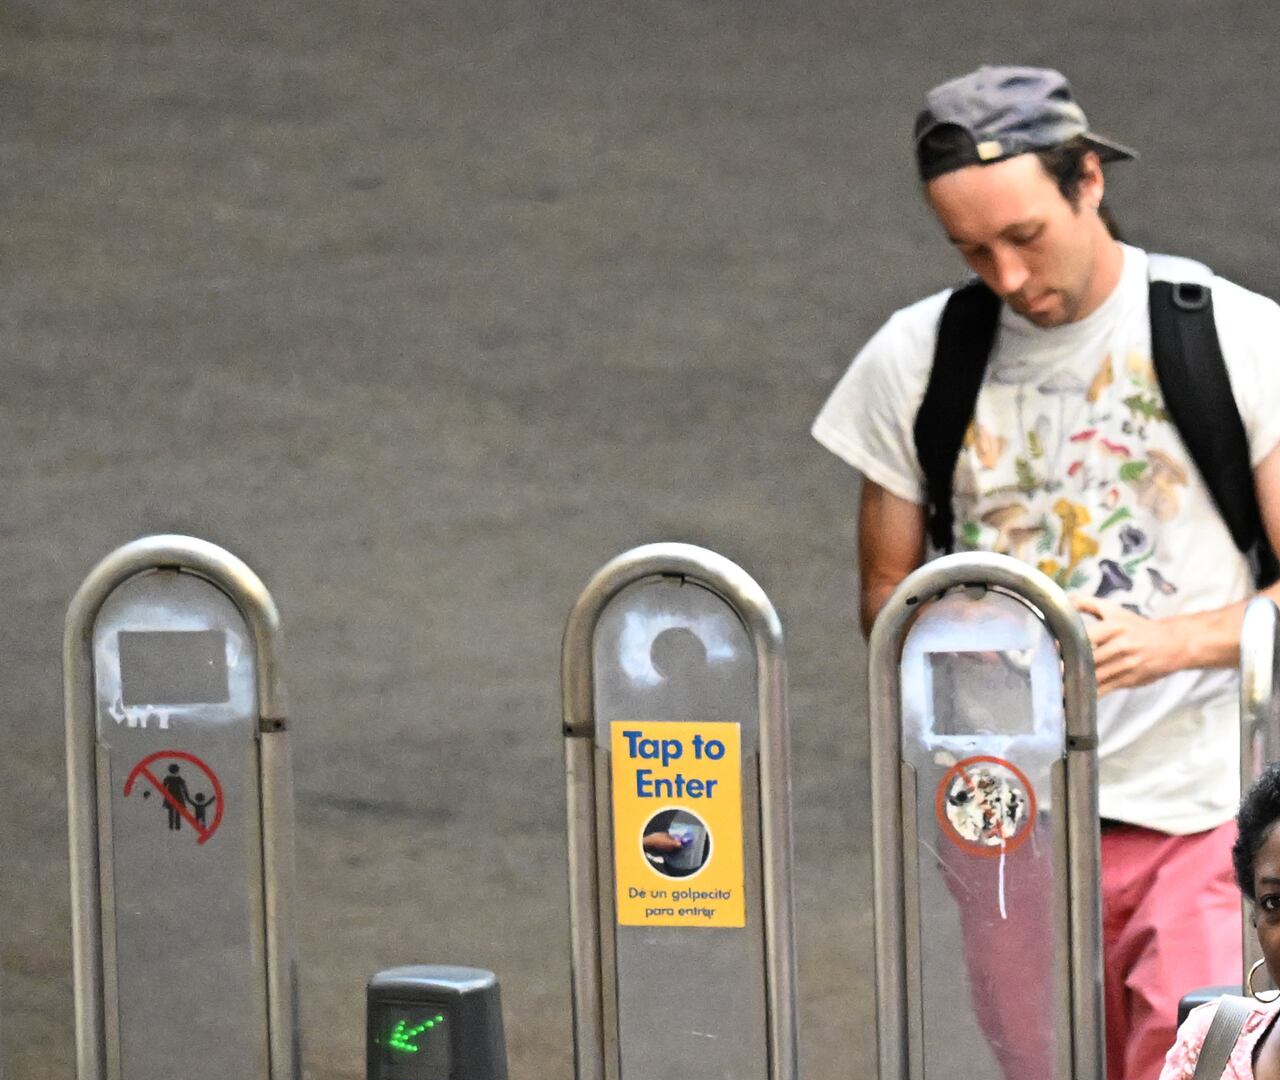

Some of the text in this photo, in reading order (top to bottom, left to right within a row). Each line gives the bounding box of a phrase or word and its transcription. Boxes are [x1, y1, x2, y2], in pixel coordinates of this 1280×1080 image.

[623, 731, 725, 767] Tap to
[636, 769, 718, 798] Enter
[651, 889, 667, 898] un
[672, 888, 731, 902] golpecito
[646, 907, 674, 917] para
